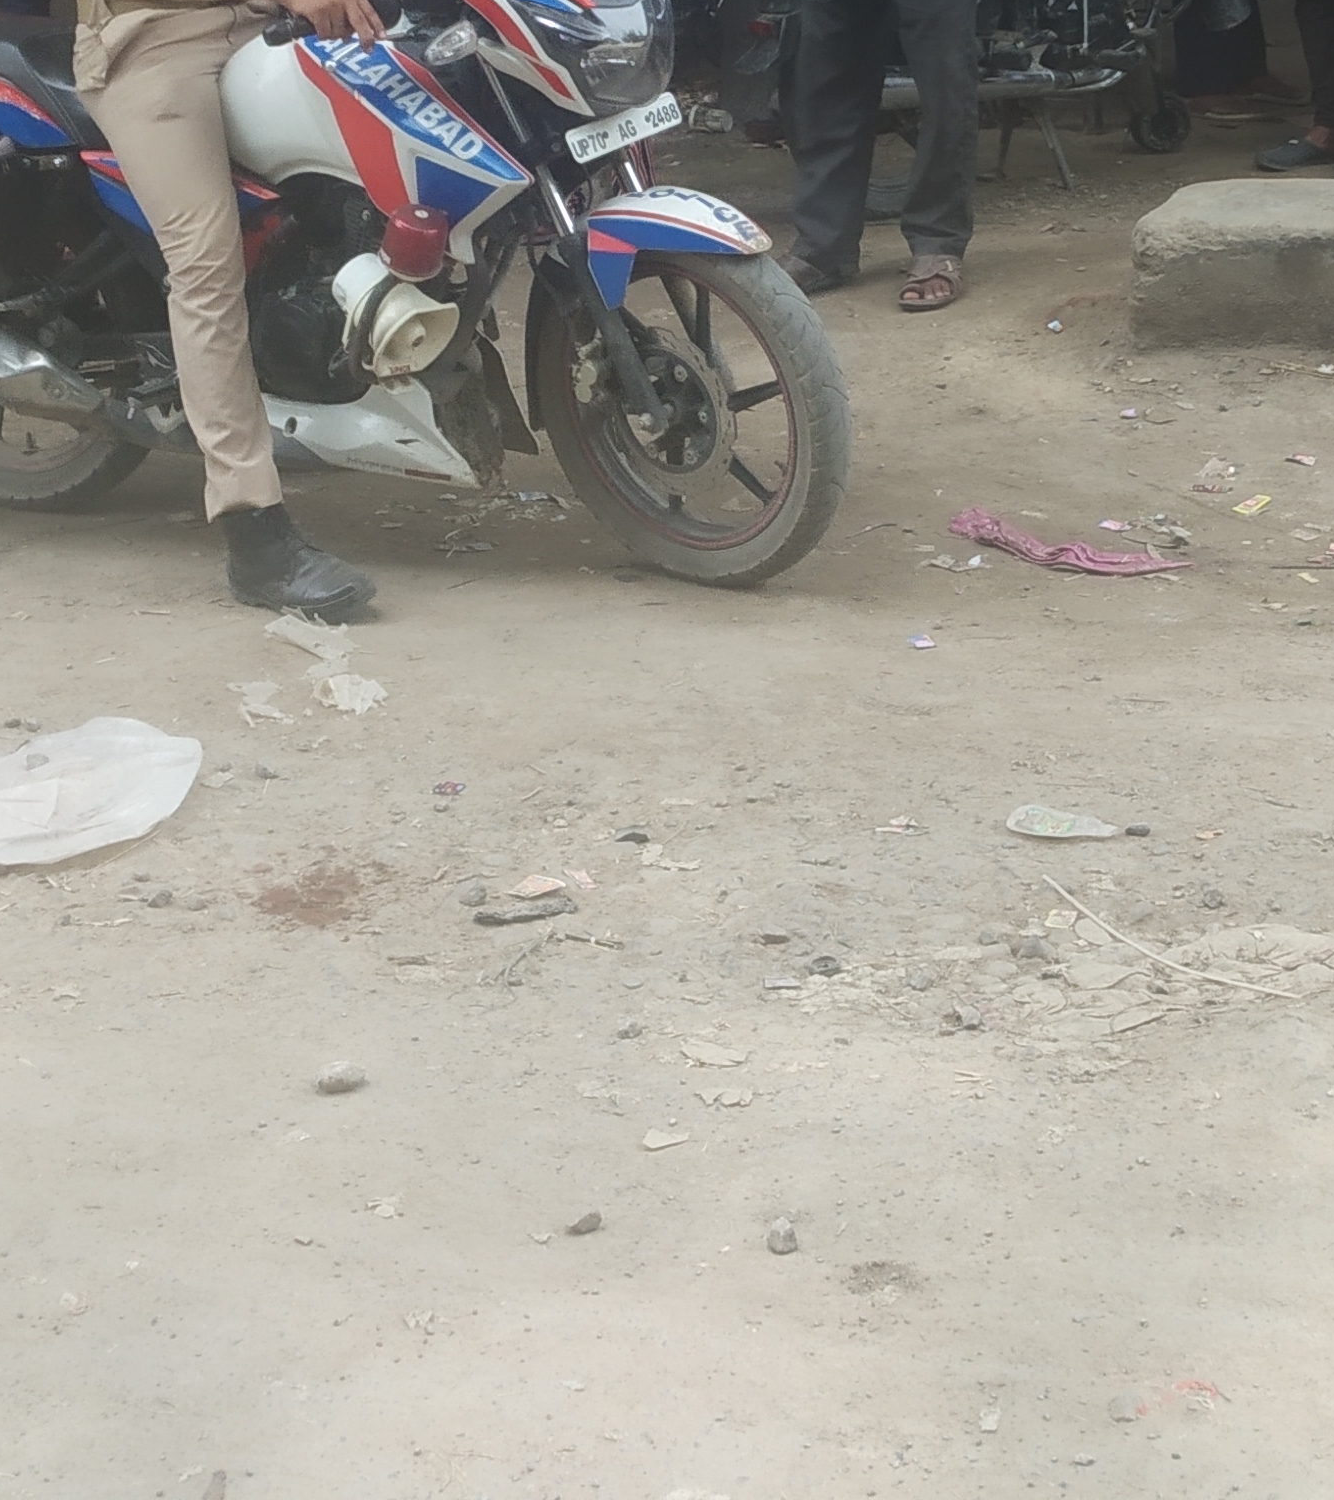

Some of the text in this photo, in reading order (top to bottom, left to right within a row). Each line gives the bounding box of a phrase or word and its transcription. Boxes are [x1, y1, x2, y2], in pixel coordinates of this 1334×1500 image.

[313, 37, 485, 161] ALLAHABAD
[617, 119, 638, 142] AG
[648, 102, 680, 129] 2488
